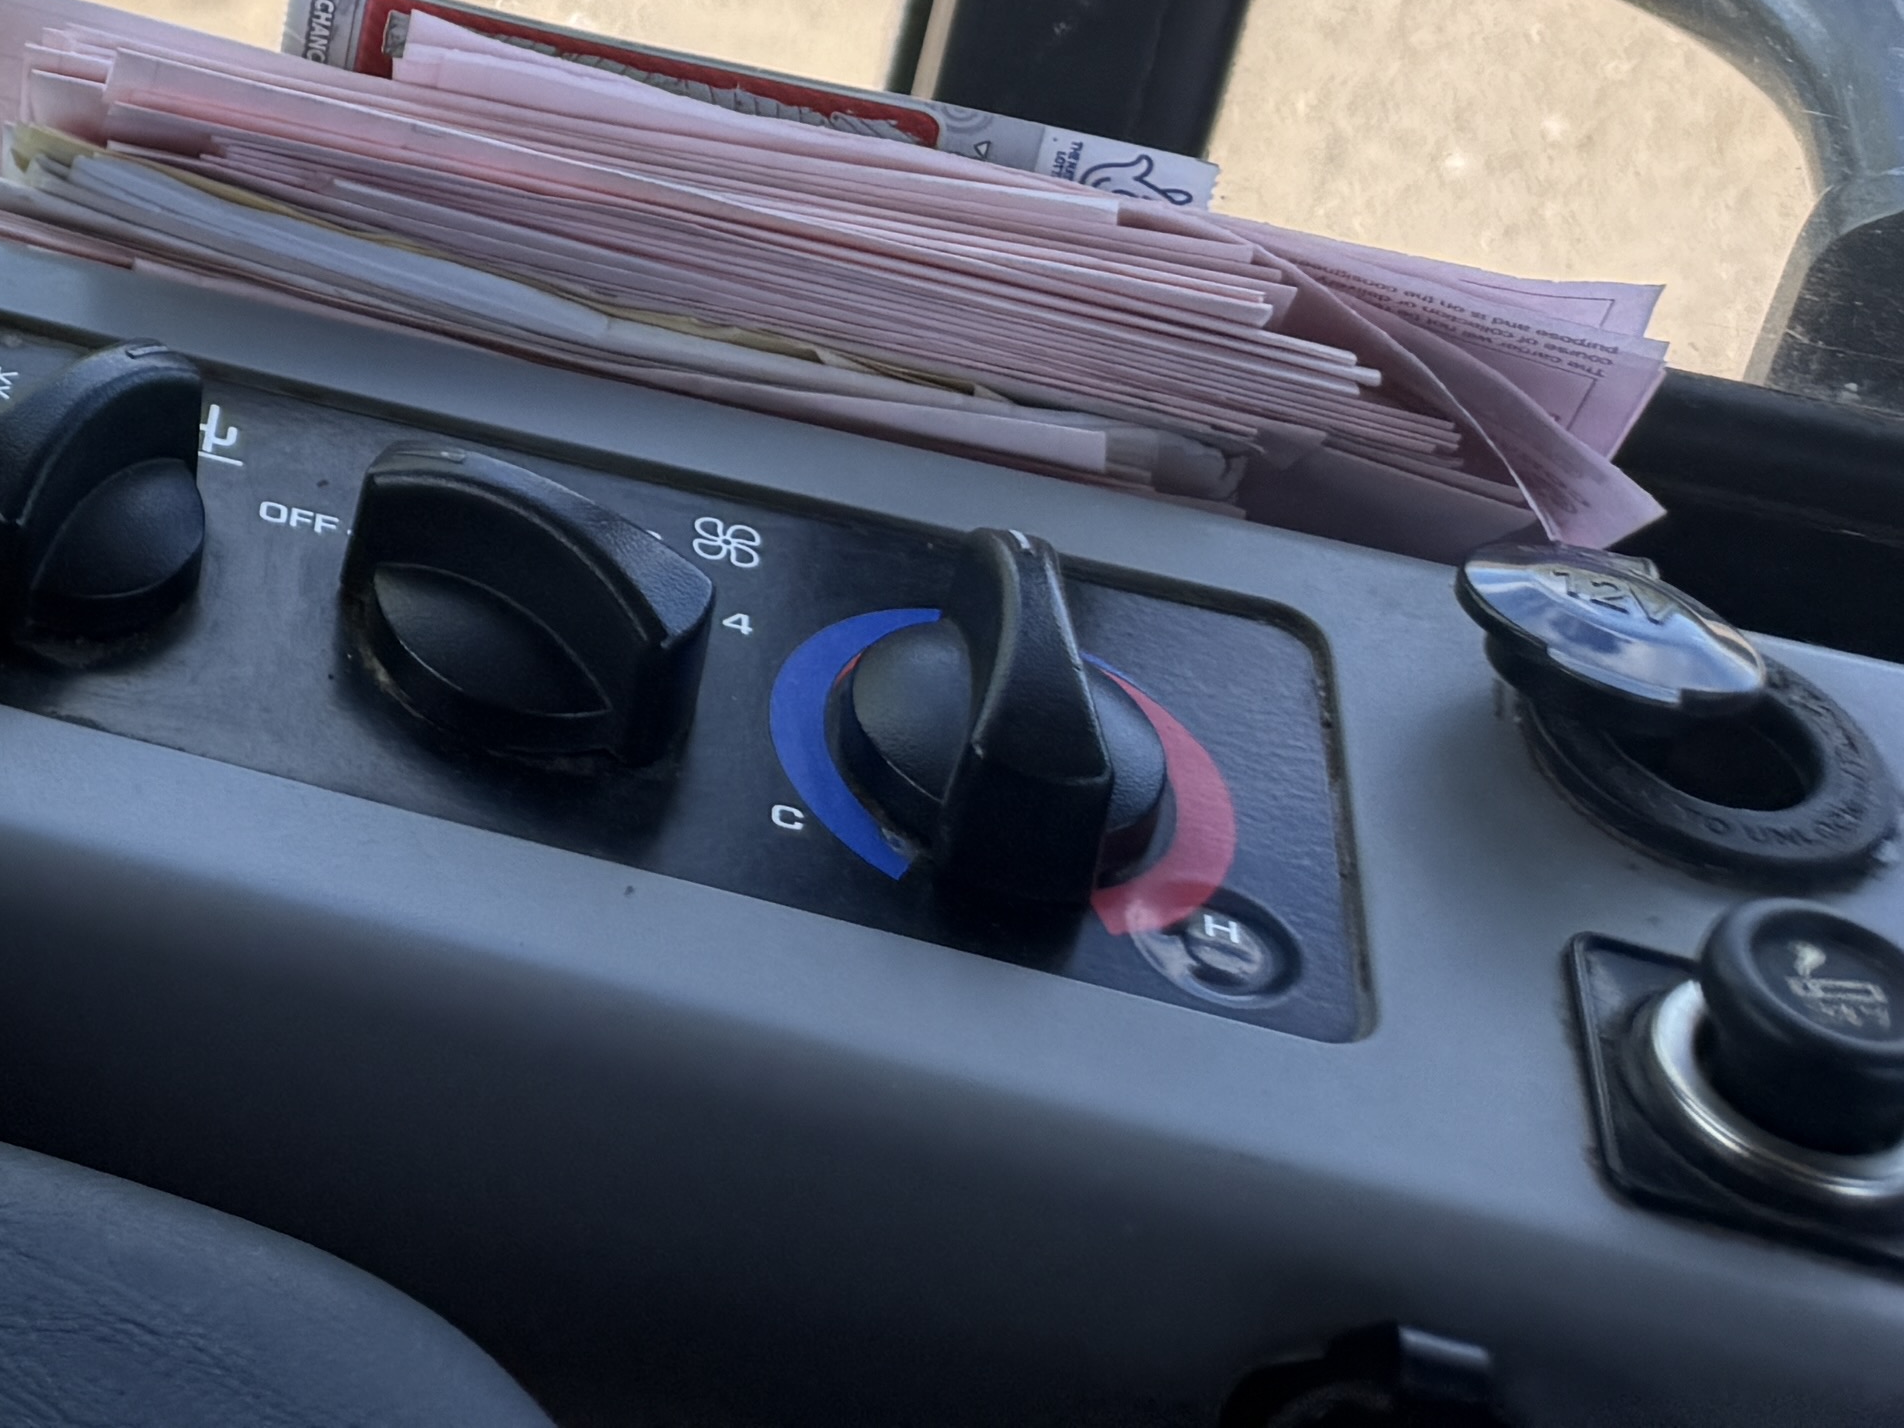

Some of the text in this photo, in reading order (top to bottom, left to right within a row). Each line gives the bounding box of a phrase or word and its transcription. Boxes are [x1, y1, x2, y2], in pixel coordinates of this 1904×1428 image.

[1403, 289, 1433, 304] the
[1440, 299, 1466, 314] on
[1422, 305, 1514, 339] collection
[1491, 316, 1531, 333] and
[1517, 334, 1539, 346] of
[1535, 328, 1619, 355] purpose
[1544, 342, 1613, 366] course
[1567, 360, 1606, 379] The
[259, 500, 340, 534] OFF
[1551, 566, 1675, 627] 12V
[722, 613, 753, 635] 4
[771, 804, 805, 831] C
[1203, 913, 1240, 944] H
